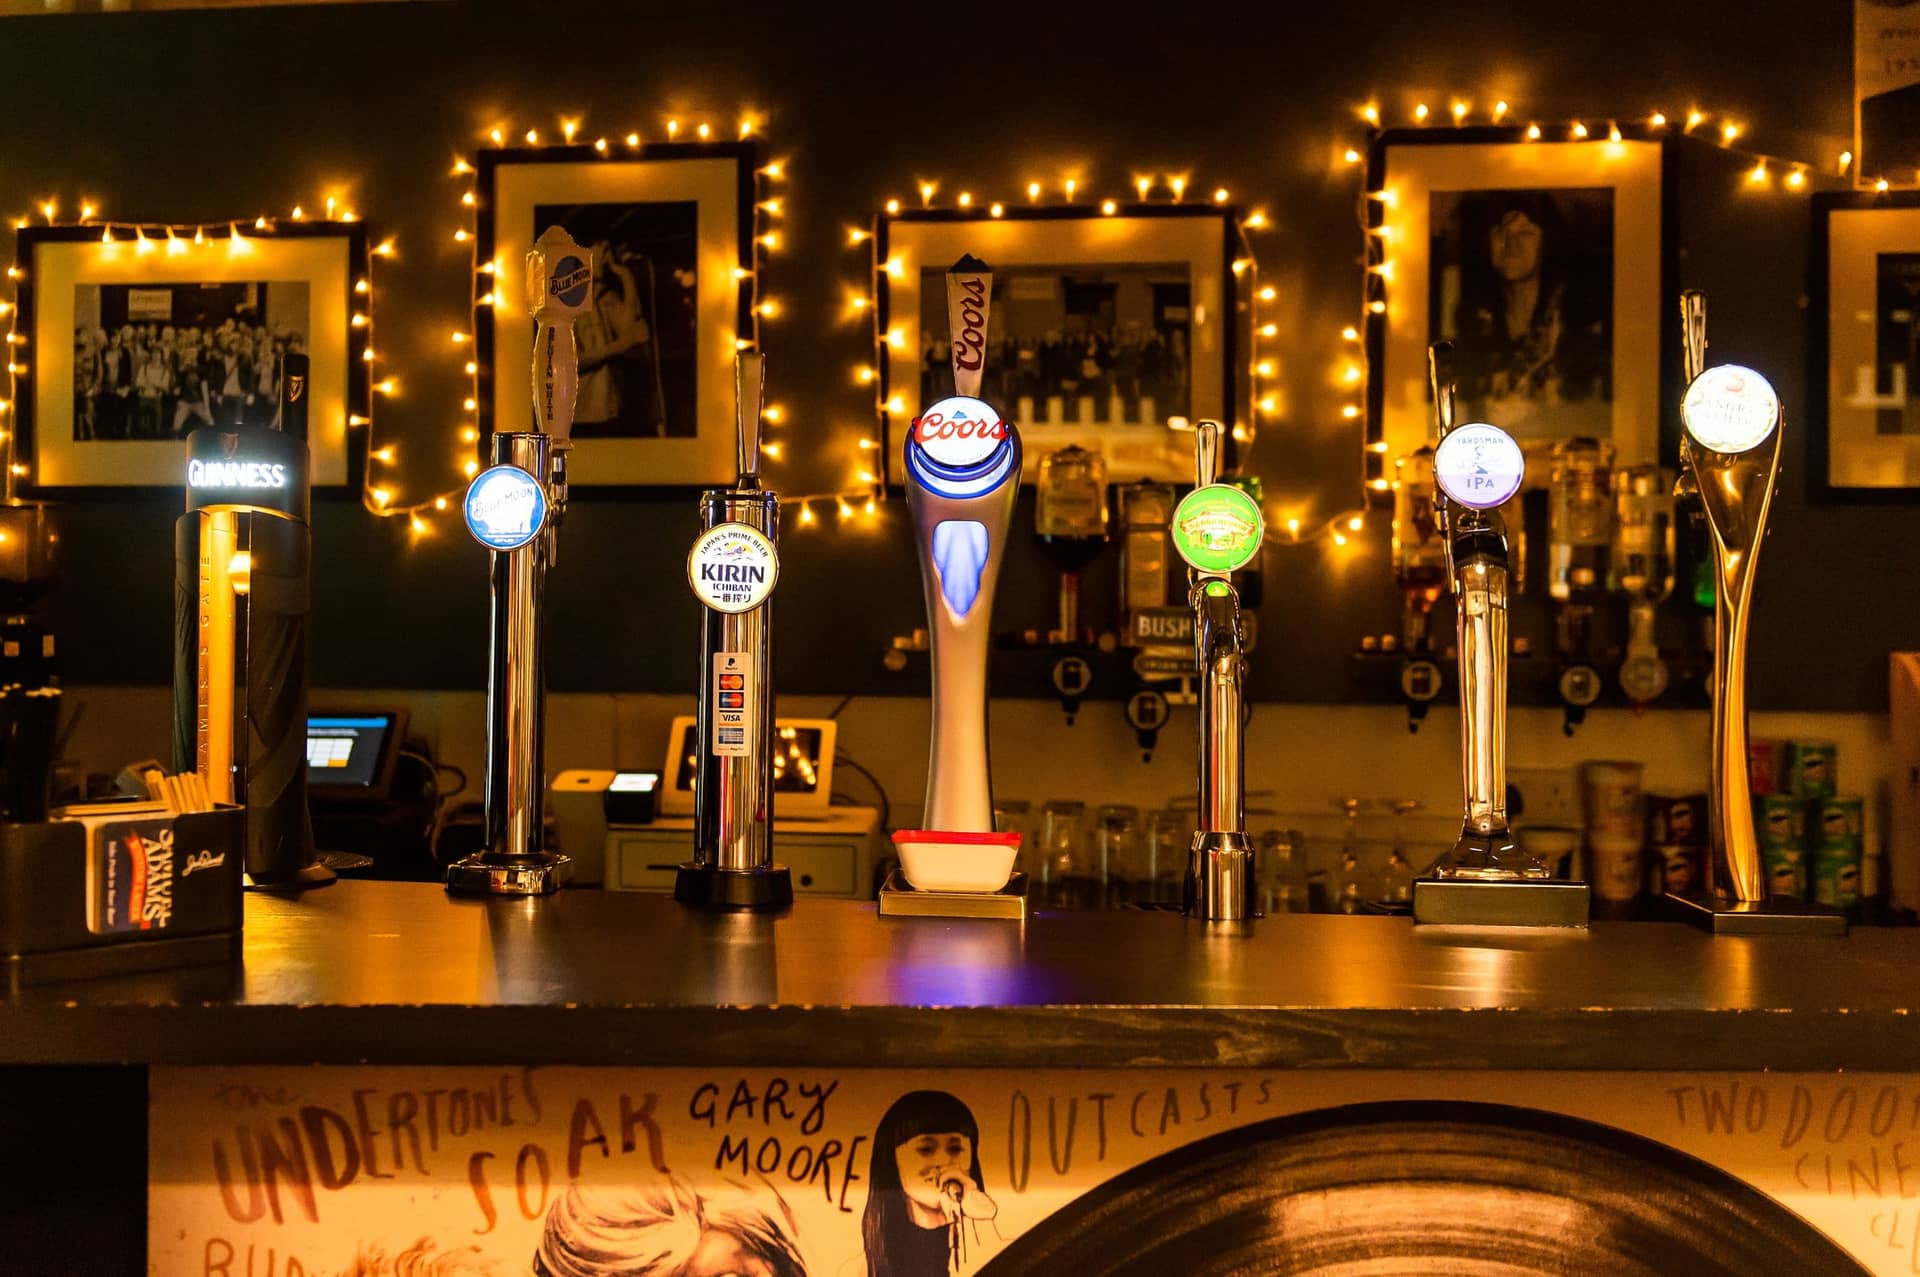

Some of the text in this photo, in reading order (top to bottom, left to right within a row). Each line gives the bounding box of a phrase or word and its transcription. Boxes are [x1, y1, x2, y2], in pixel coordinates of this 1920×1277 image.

[955, 278, 985, 371] Coors
[912, 412, 1009, 445] Coors
[187, 459, 285, 488] GUINNESS
[504, 487, 533, 504] MOON
[1467, 477, 1494, 489] IPA
[701, 532, 769, 558] JAPAN'S PRIME BEER
[701, 563, 765, 583] KIRIN
[713, 583, 751, 592] ICHIBAN
[141, 838, 162, 921] ADAMS
[689, 1078, 838, 1135] GARY
[1665, 1080, 1920, 1149] TWO DOO
[212, 1068, 541, 1225] UNDERTONES
[1007, 1078, 1275, 1194] OUTCASTS
[715, 1135, 867, 1213] MOORE
